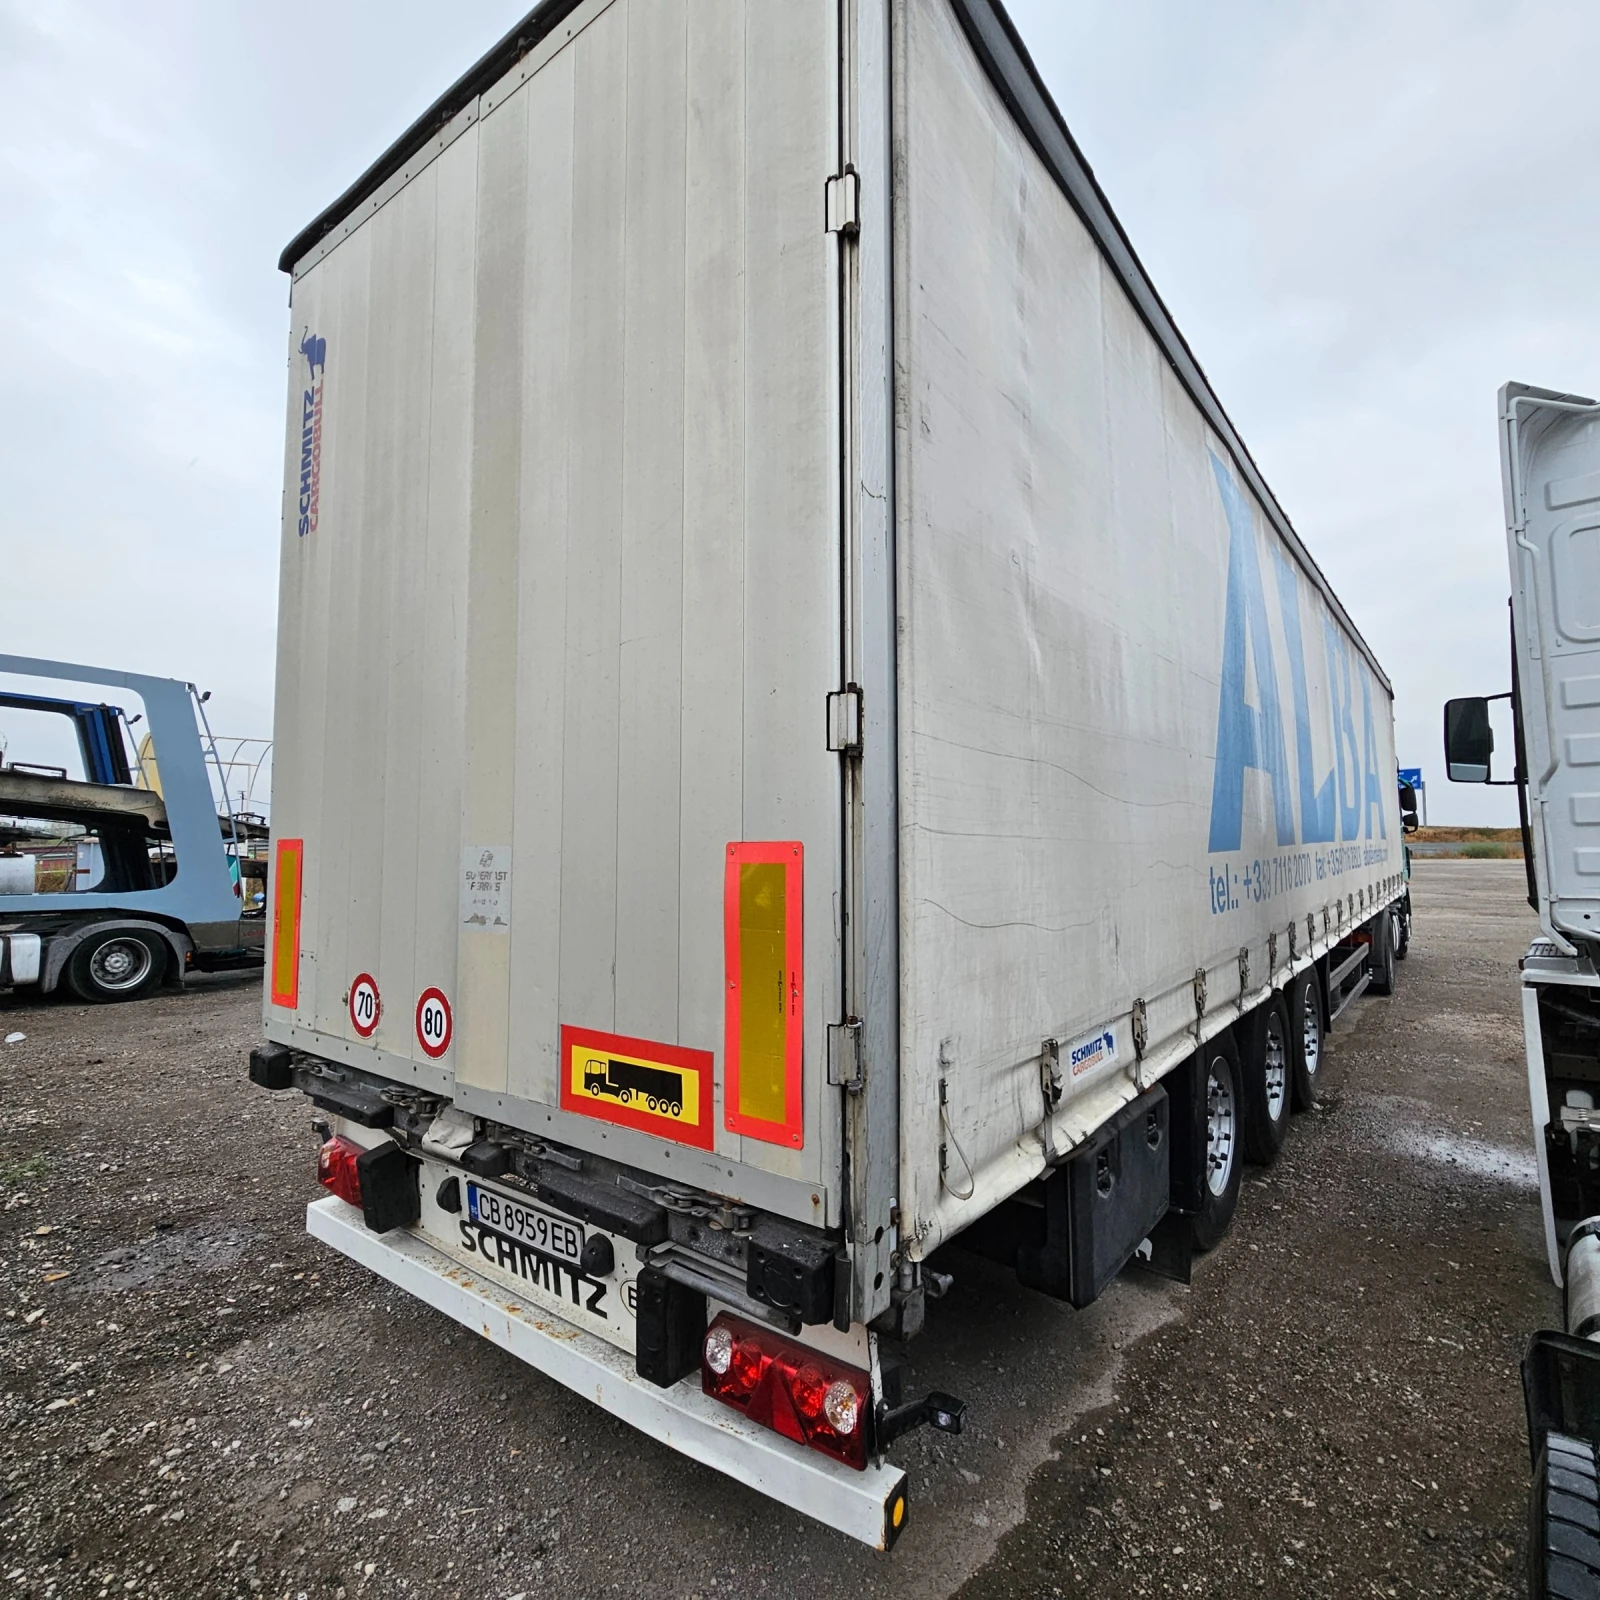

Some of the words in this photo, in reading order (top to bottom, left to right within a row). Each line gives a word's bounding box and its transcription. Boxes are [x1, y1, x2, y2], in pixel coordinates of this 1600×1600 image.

[299, 386, 315, 538] SCHMITZ
[310, 378, 323, 533] CARGOBULL
[1207, 446, 1386, 854] ALBA
[357, 990, 373, 1020] 70
[424, 1007, 443, 1038] 80
[1072, 1037, 1102, 1065] SCHMITZ
[479, 1193, 501, 1225] CB
[504, 1204, 548, 1246] 8959
[551, 1222, 578, 1258] EB
[459, 1219, 608, 1320] SCHMITZ
